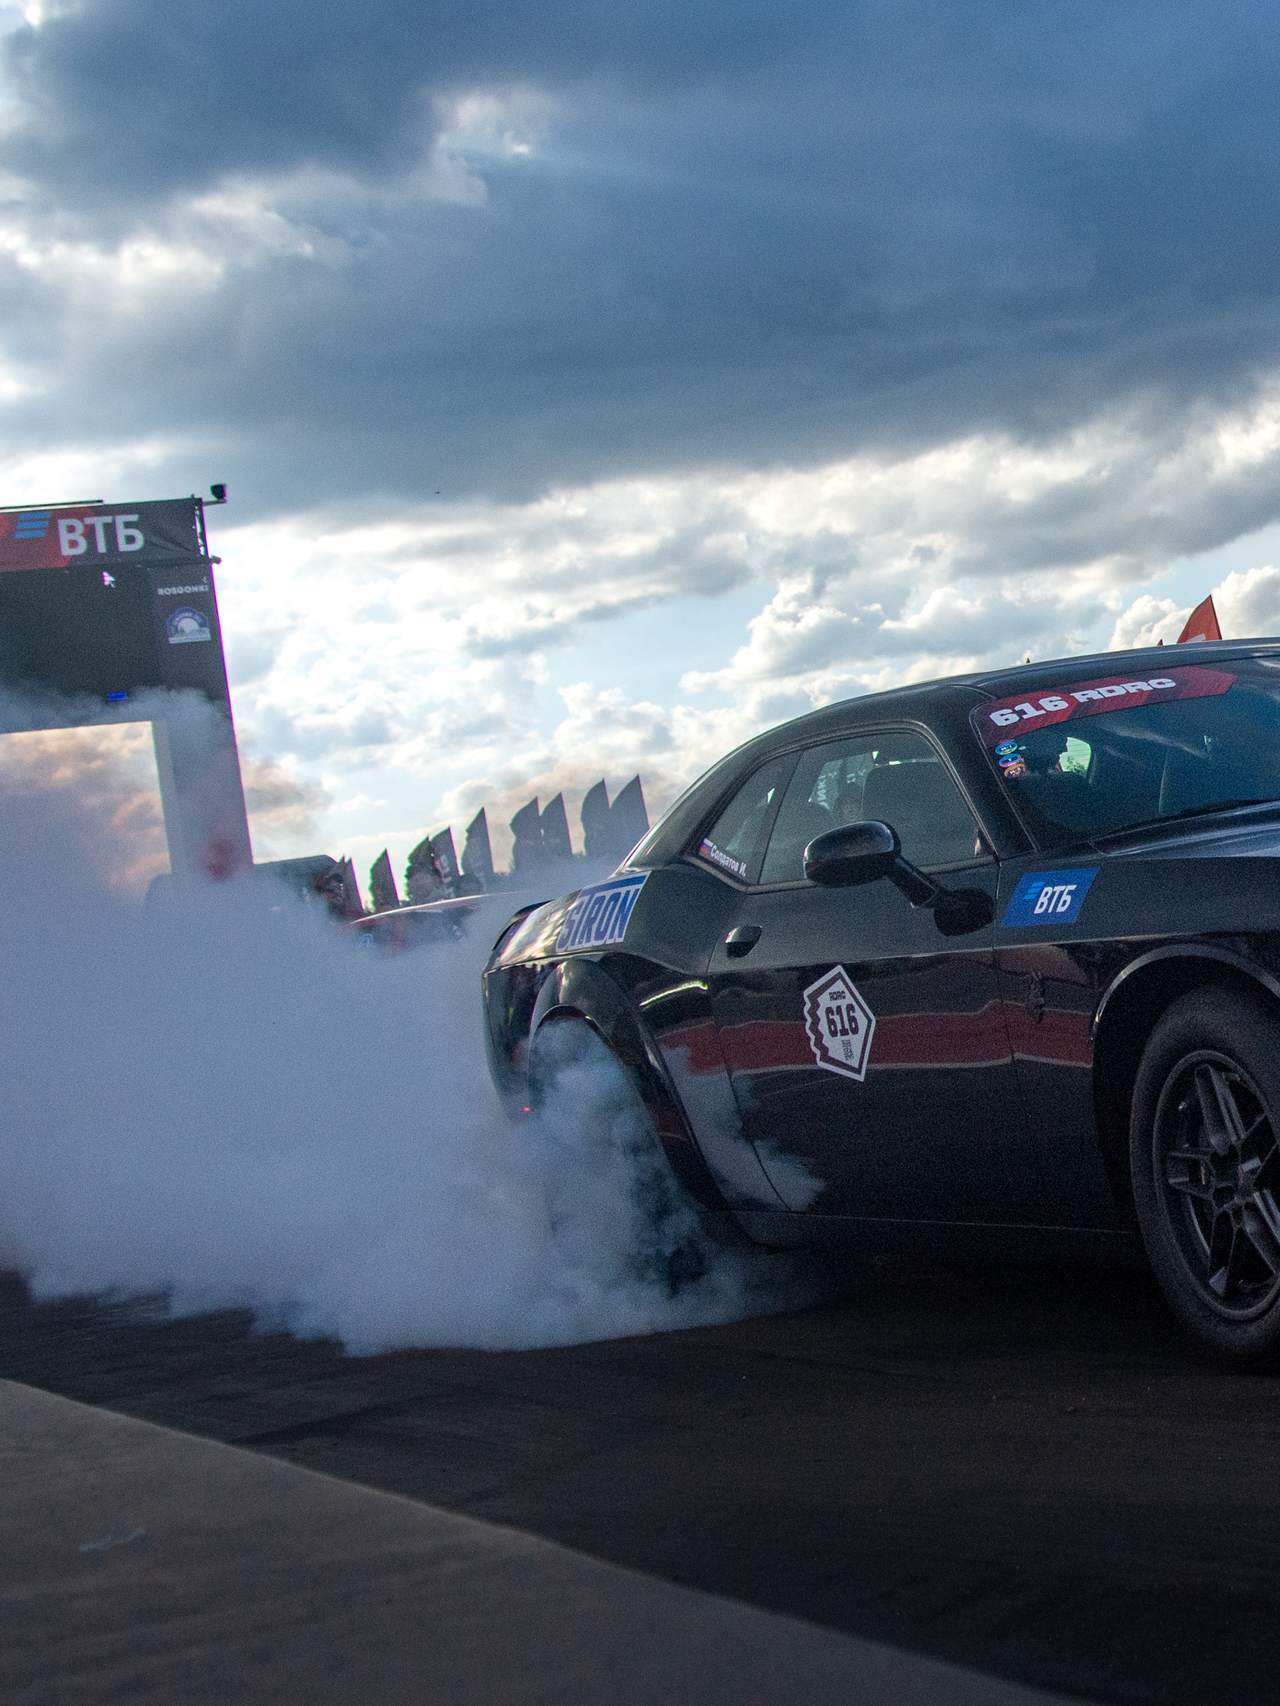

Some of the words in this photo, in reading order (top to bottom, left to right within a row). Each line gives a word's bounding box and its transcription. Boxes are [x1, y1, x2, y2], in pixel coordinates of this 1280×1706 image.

[57, 514, 145, 556] ВТБ
[989, 696, 1069, 727] 616
[1070, 678, 1176, 703] RDRC
[711, 845, 740, 872] Солдатов
[1033, 885, 1078, 914] ВТБ
[825, 1003, 860, 1038] 616
